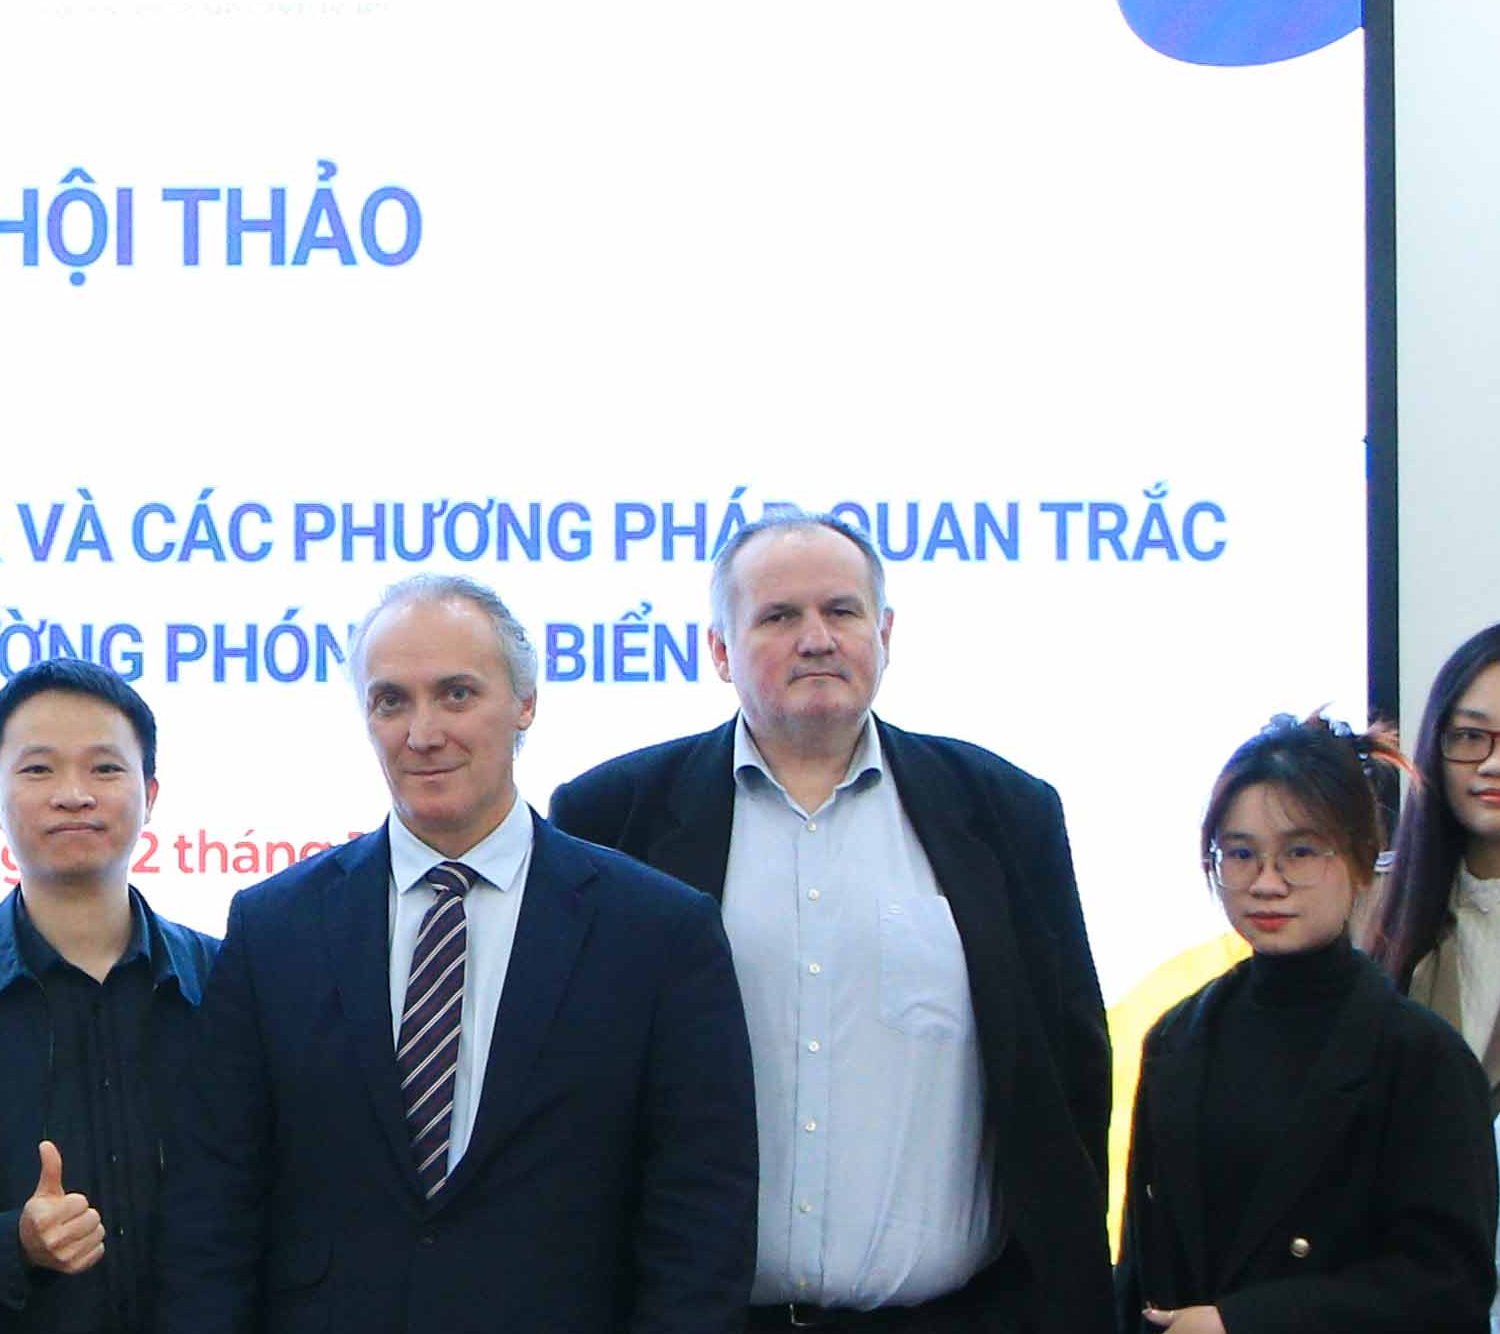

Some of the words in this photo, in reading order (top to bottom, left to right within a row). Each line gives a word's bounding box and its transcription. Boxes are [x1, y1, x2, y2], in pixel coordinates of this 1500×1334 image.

[161, 159, 423, 267] THẢO
[16, 487, 114, 563] VÀ
[131, 486, 274, 563] CÁC
[293, 498, 592, 563] PHƯƠNG
[614, 486, 803, 562] PHÁ
[1039, 481, 1228, 562] TRẮC
[545, 601, 699, 683] BIỂN
